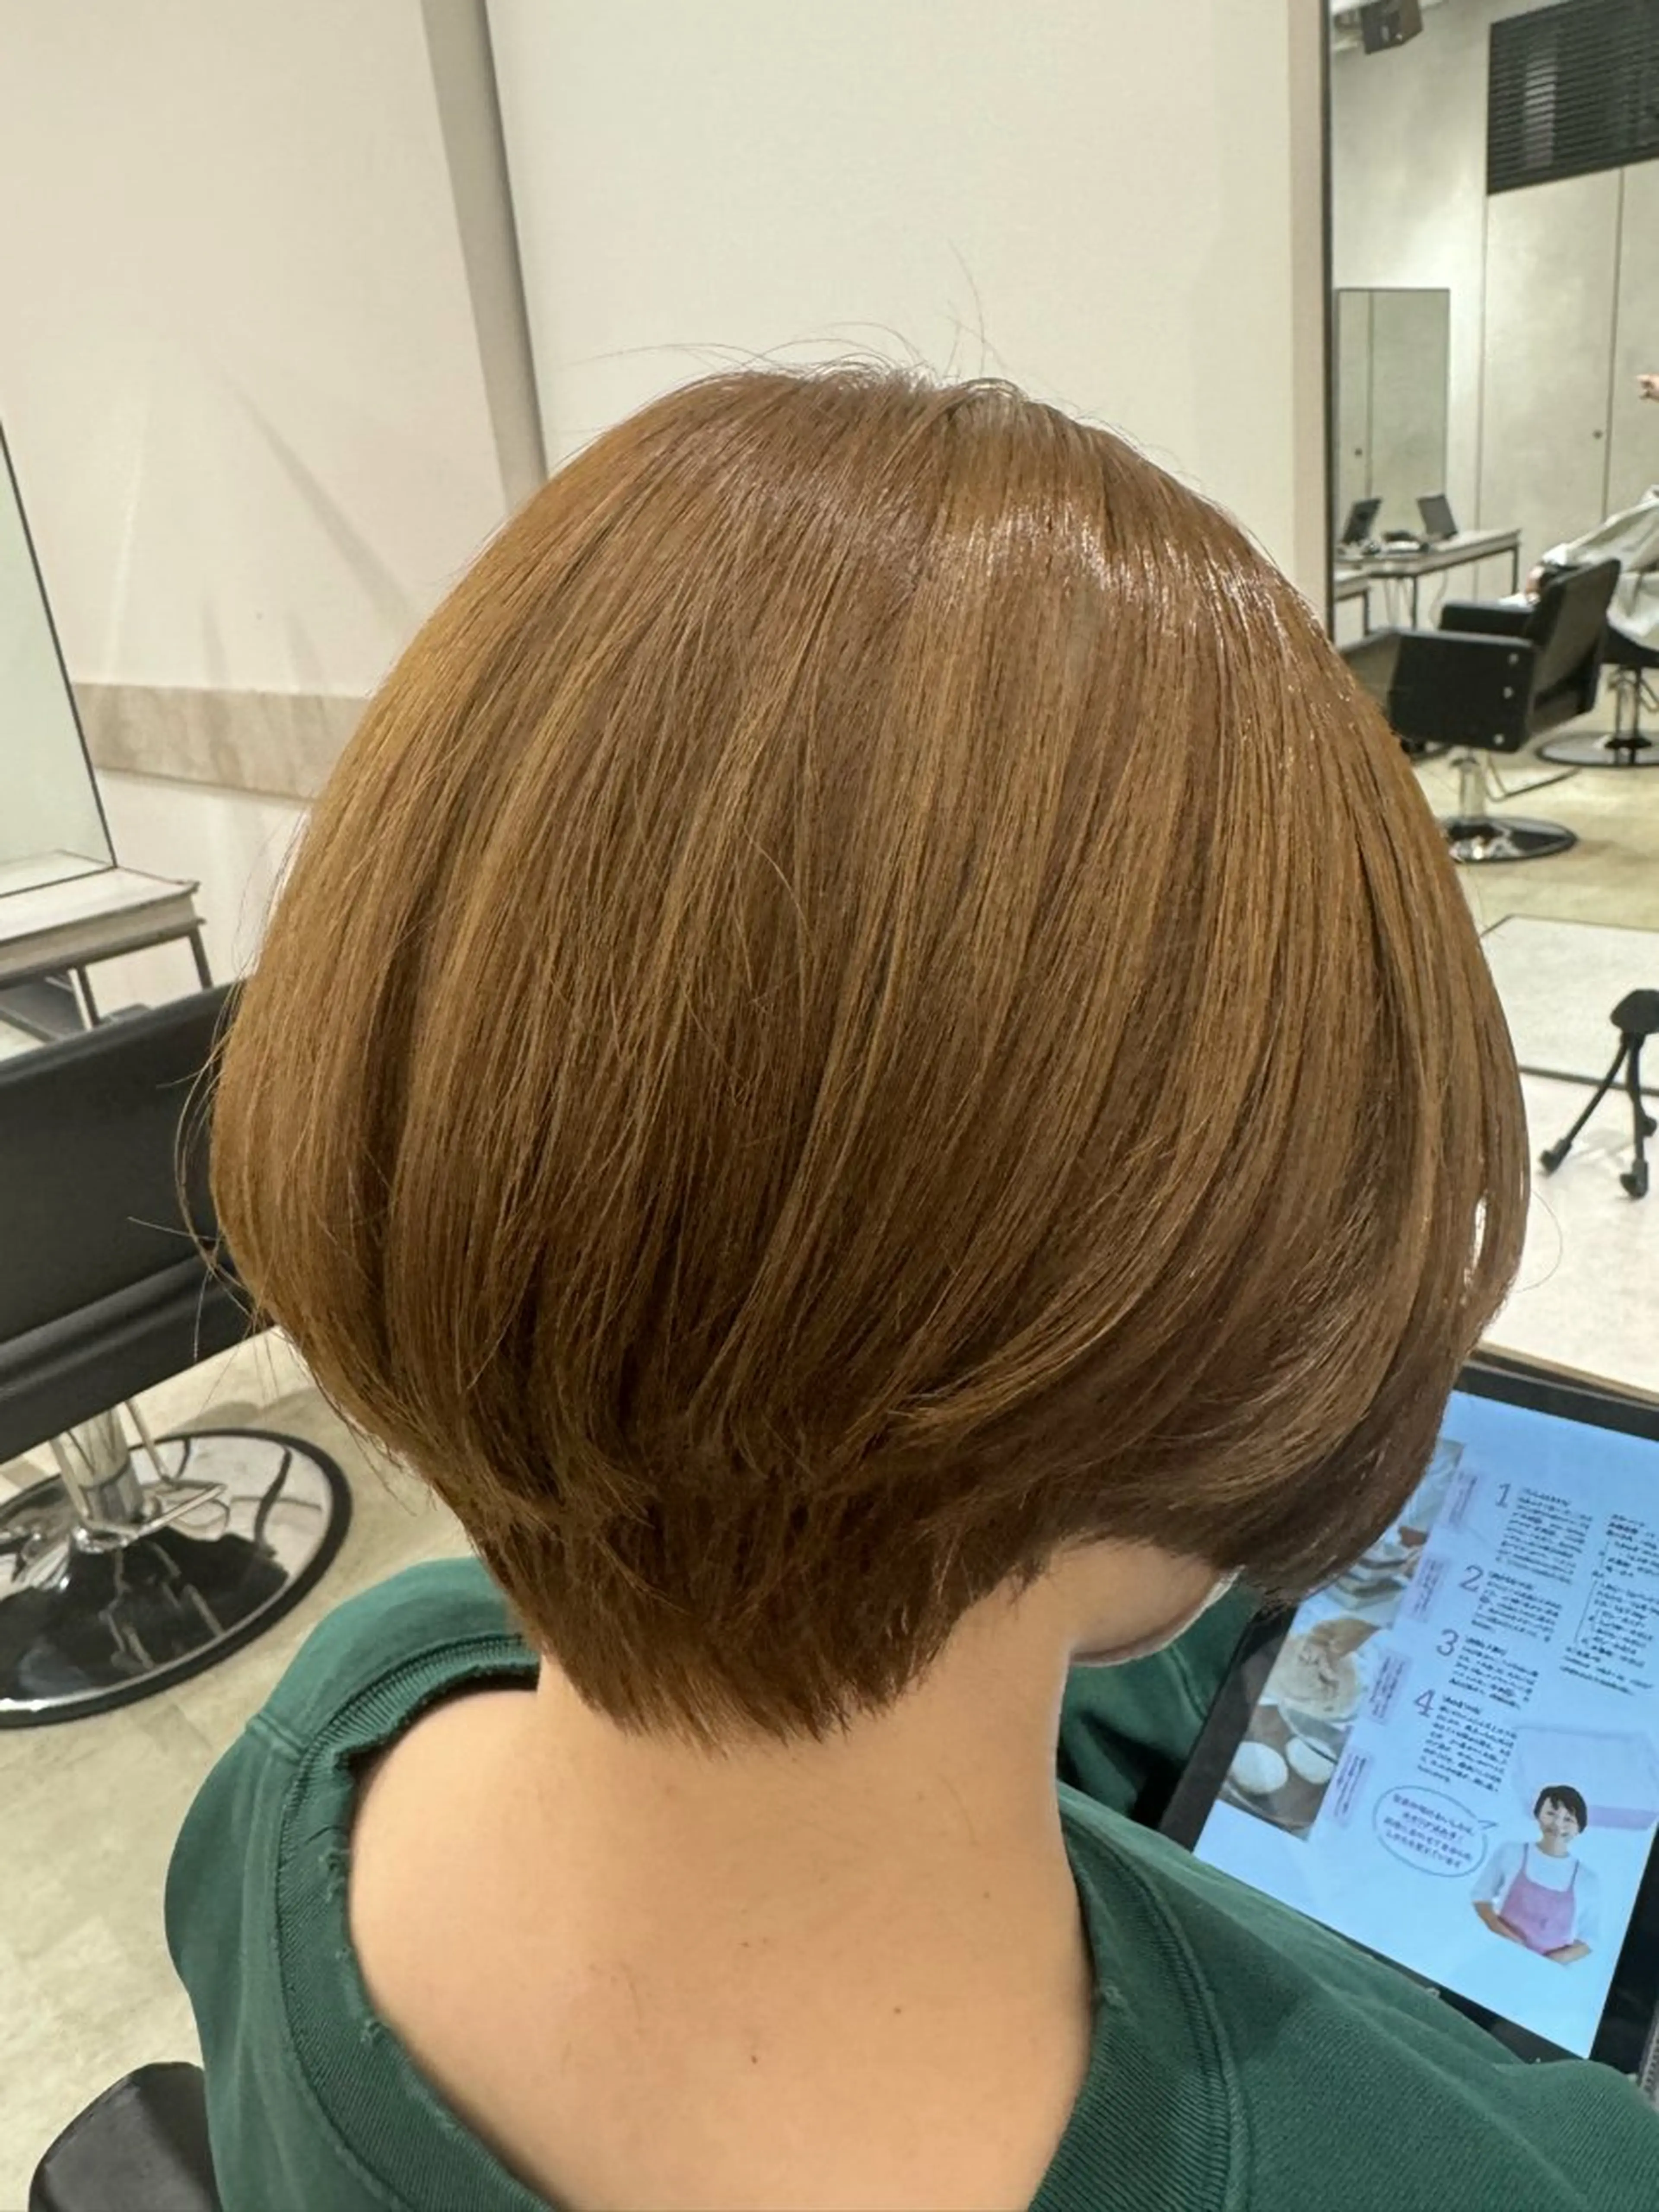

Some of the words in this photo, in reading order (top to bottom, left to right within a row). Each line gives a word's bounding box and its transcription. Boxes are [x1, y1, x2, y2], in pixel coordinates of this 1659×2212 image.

[1495, 1483, 1511, 1508] 1
[1459, 1564, 1484, 1592] 2
[1437, 1628, 1459, 1656] 3
[1414, 1689, 1436, 1718] 4
